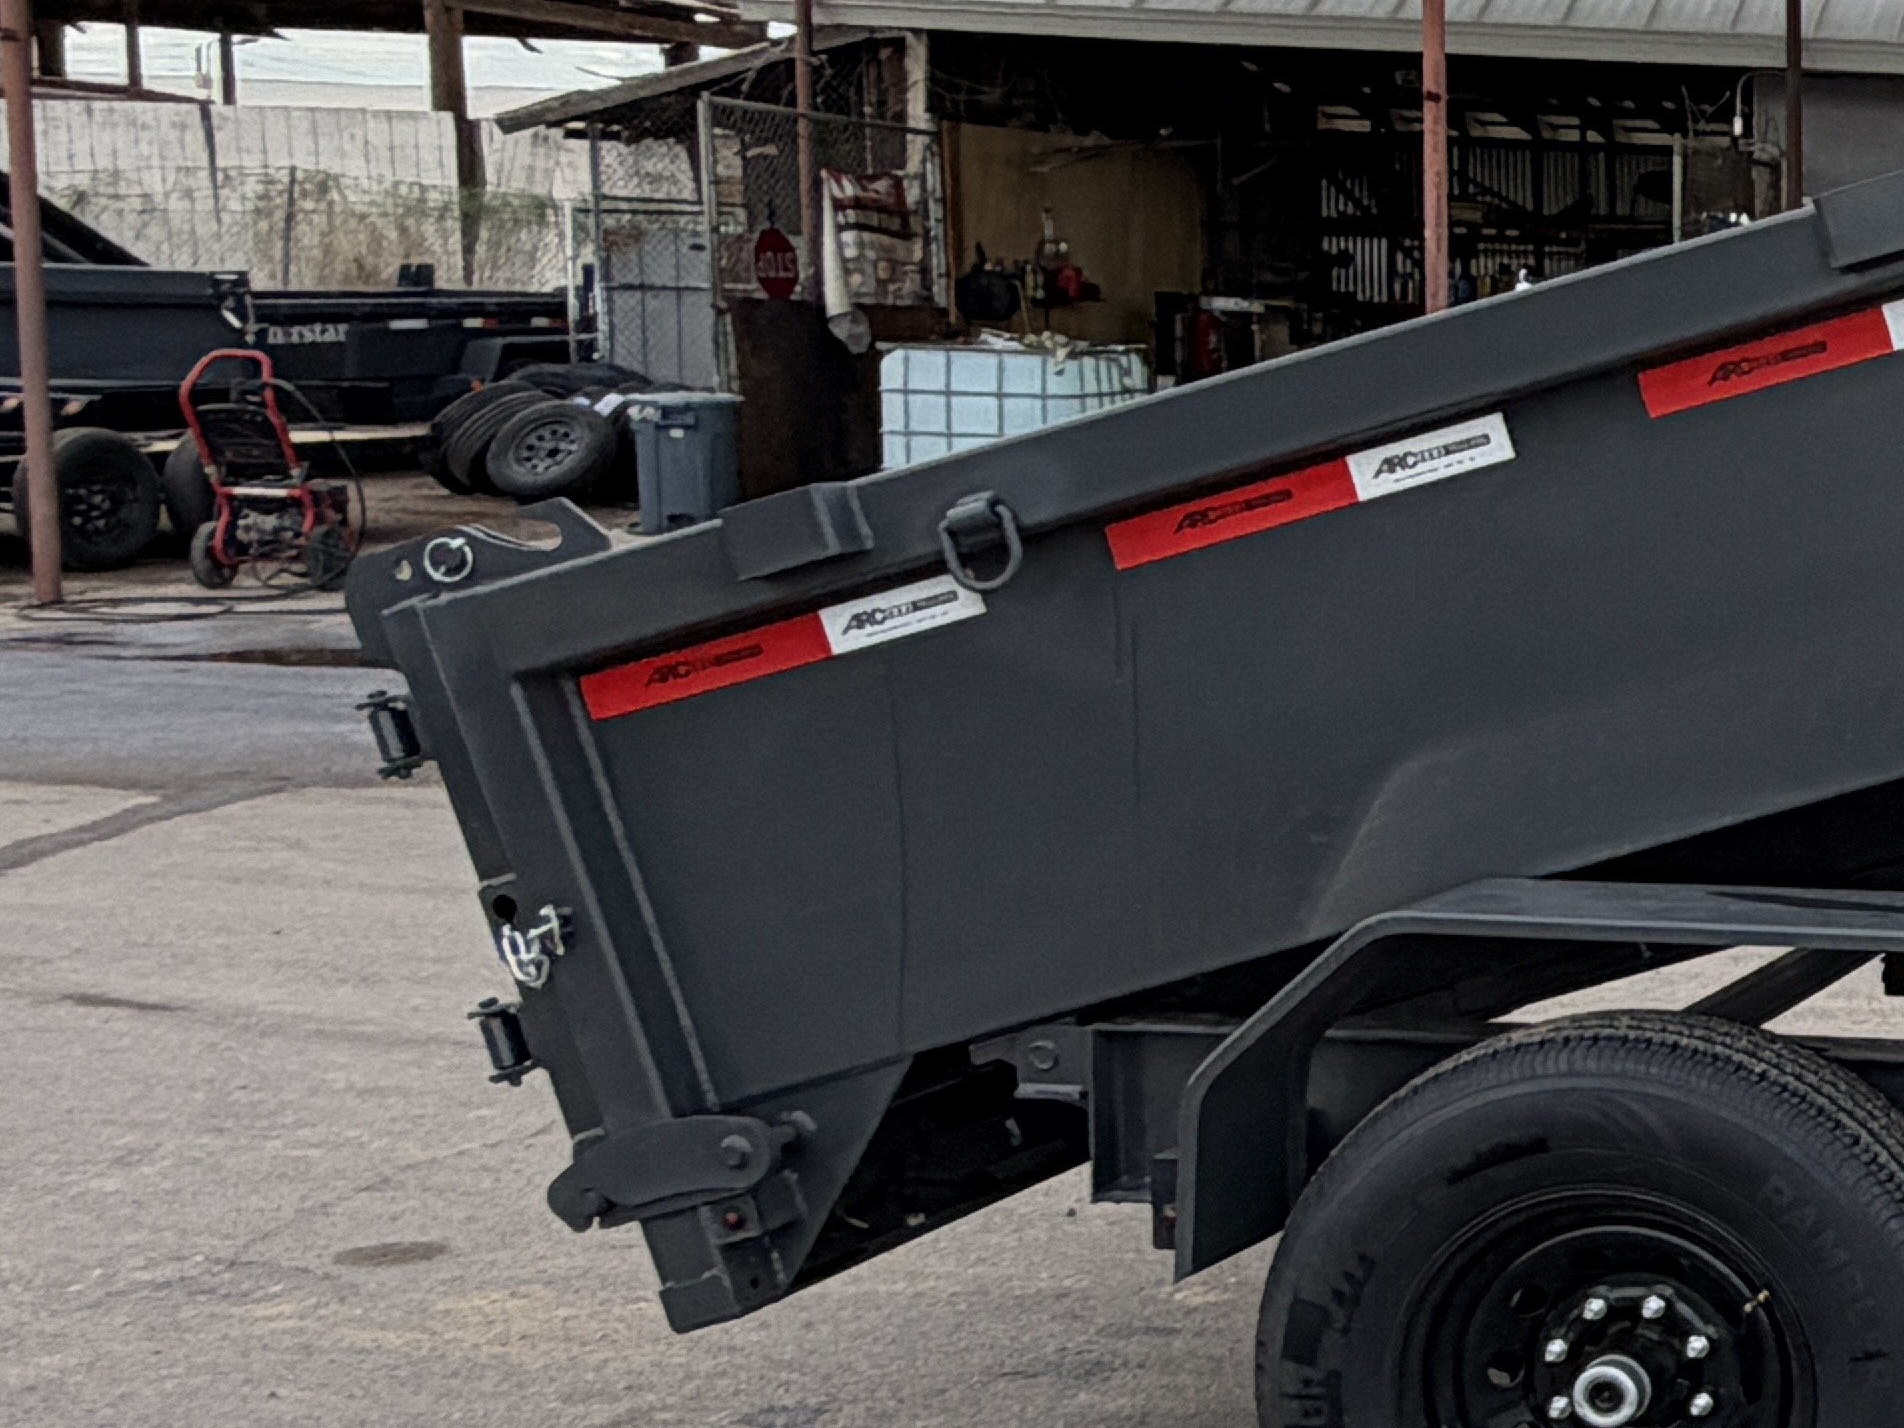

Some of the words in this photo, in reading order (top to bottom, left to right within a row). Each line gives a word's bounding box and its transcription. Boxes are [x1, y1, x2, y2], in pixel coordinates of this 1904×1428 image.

[758, 250, 796, 278] STOP
[267, 322, 349, 344] nrstar
[1372, 454, 1417, 479] ARC
[842, 608, 887, 636] ARC
